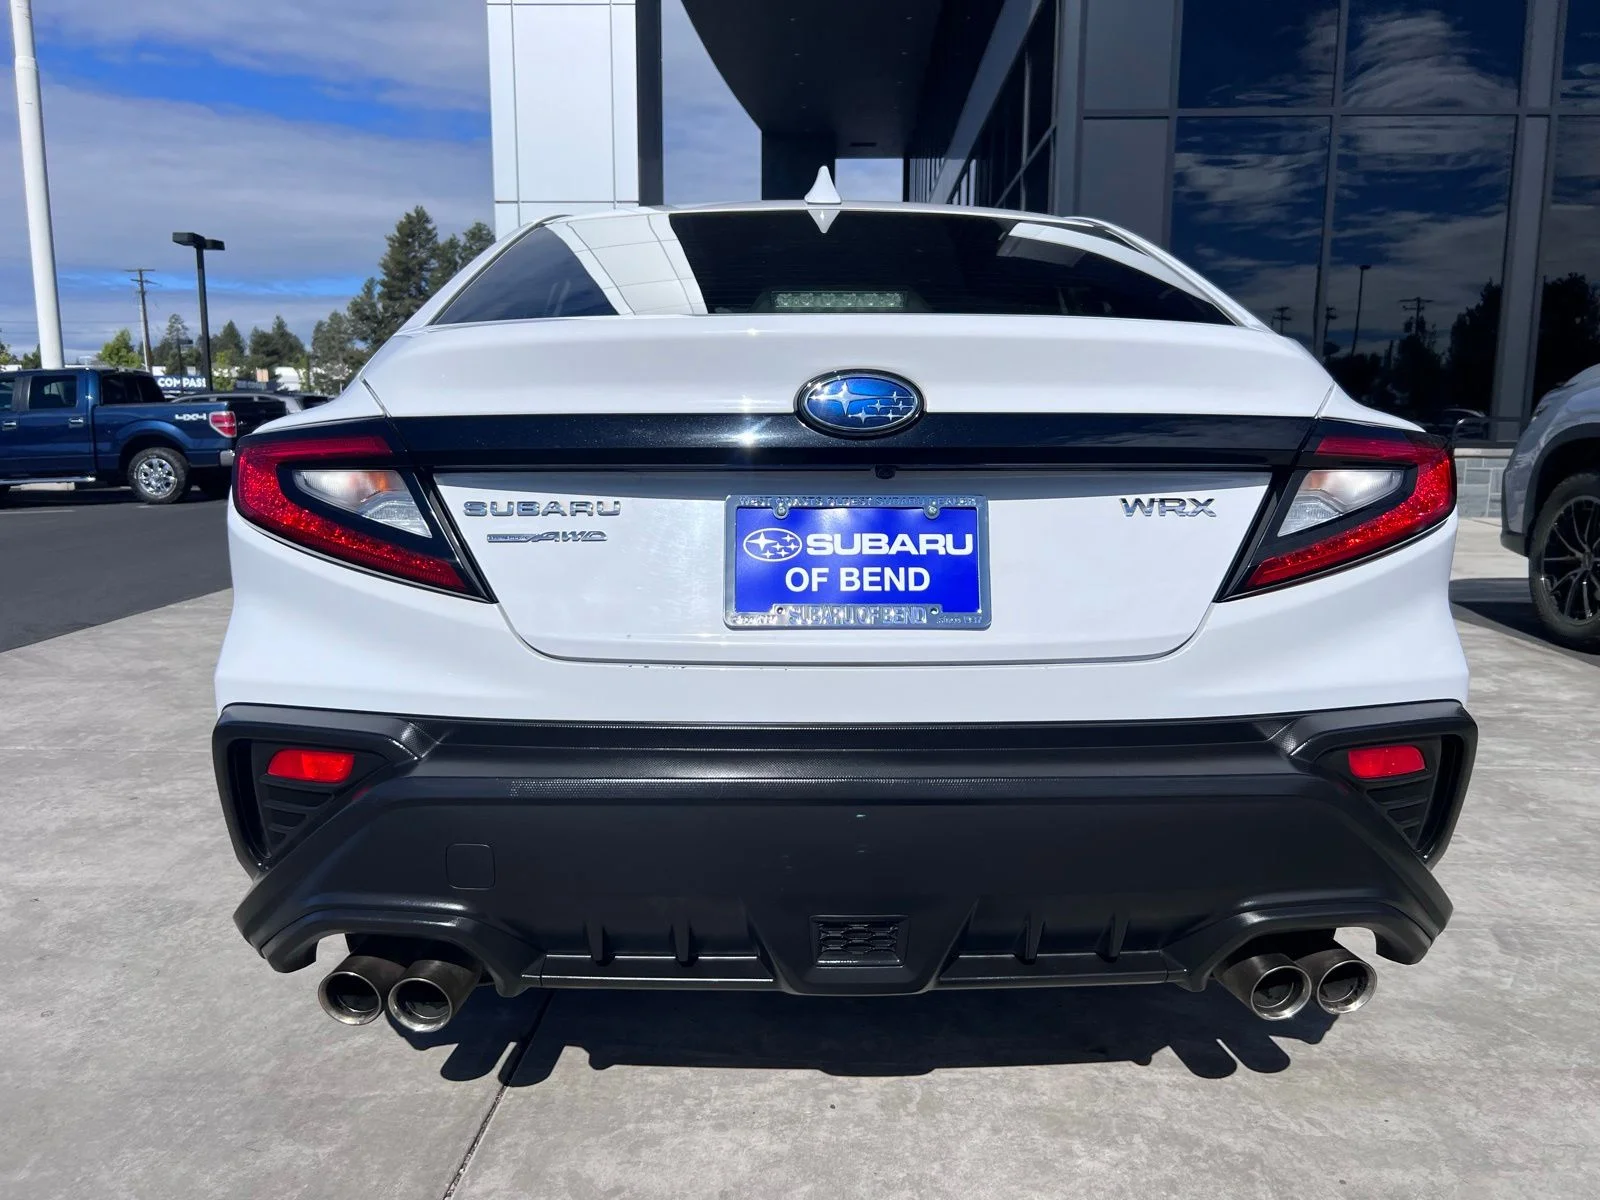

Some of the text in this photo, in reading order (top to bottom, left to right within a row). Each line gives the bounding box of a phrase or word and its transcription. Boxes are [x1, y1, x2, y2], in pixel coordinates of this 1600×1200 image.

[463, 500, 621, 517] SUBARU
[876, 496, 925, 506] SUBARU
[1120, 497, 1217, 517] WRX
[528, 530, 608, 543] AWD
[806, 533, 973, 555] SUBARU
[785, 567, 931, 592] OF BEND
[788, 606, 855, 625] SUBARU
[856, 606, 880, 625] OF
[882, 606, 927, 625] BEND
